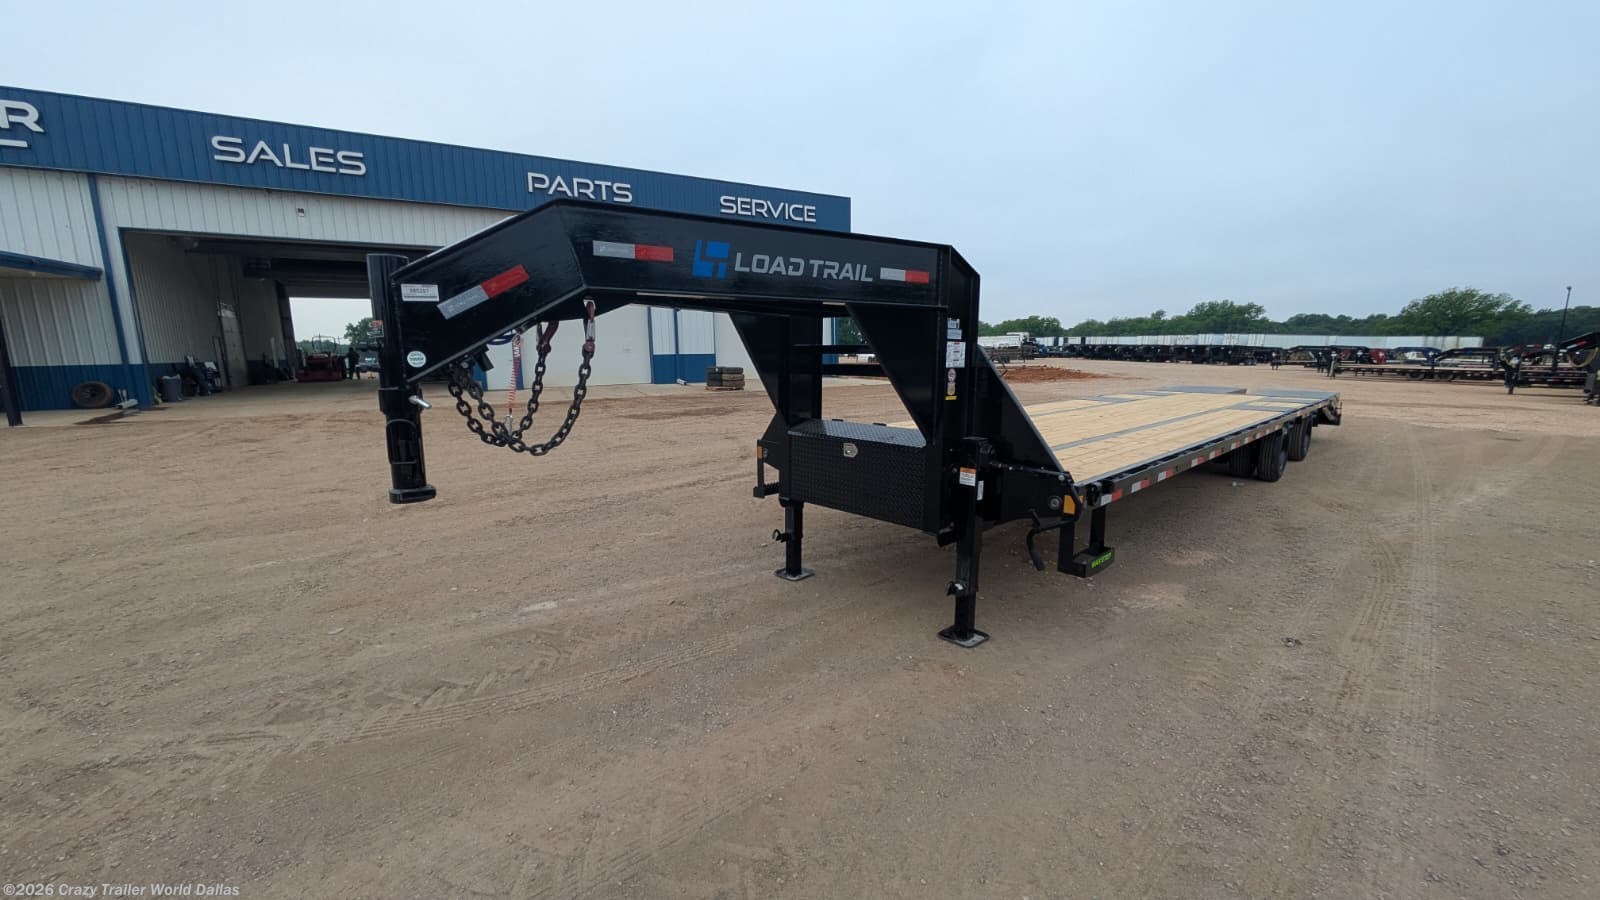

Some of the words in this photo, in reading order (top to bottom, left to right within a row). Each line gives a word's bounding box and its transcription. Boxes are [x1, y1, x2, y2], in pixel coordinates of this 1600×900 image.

[211, 135, 366, 176] SALES
[527, 172, 633, 203] PARTS
[720, 195, 817, 223] SERVICE
[734, 252, 804, 276] LOAD
[809, 259, 873, 282] TRAIL
